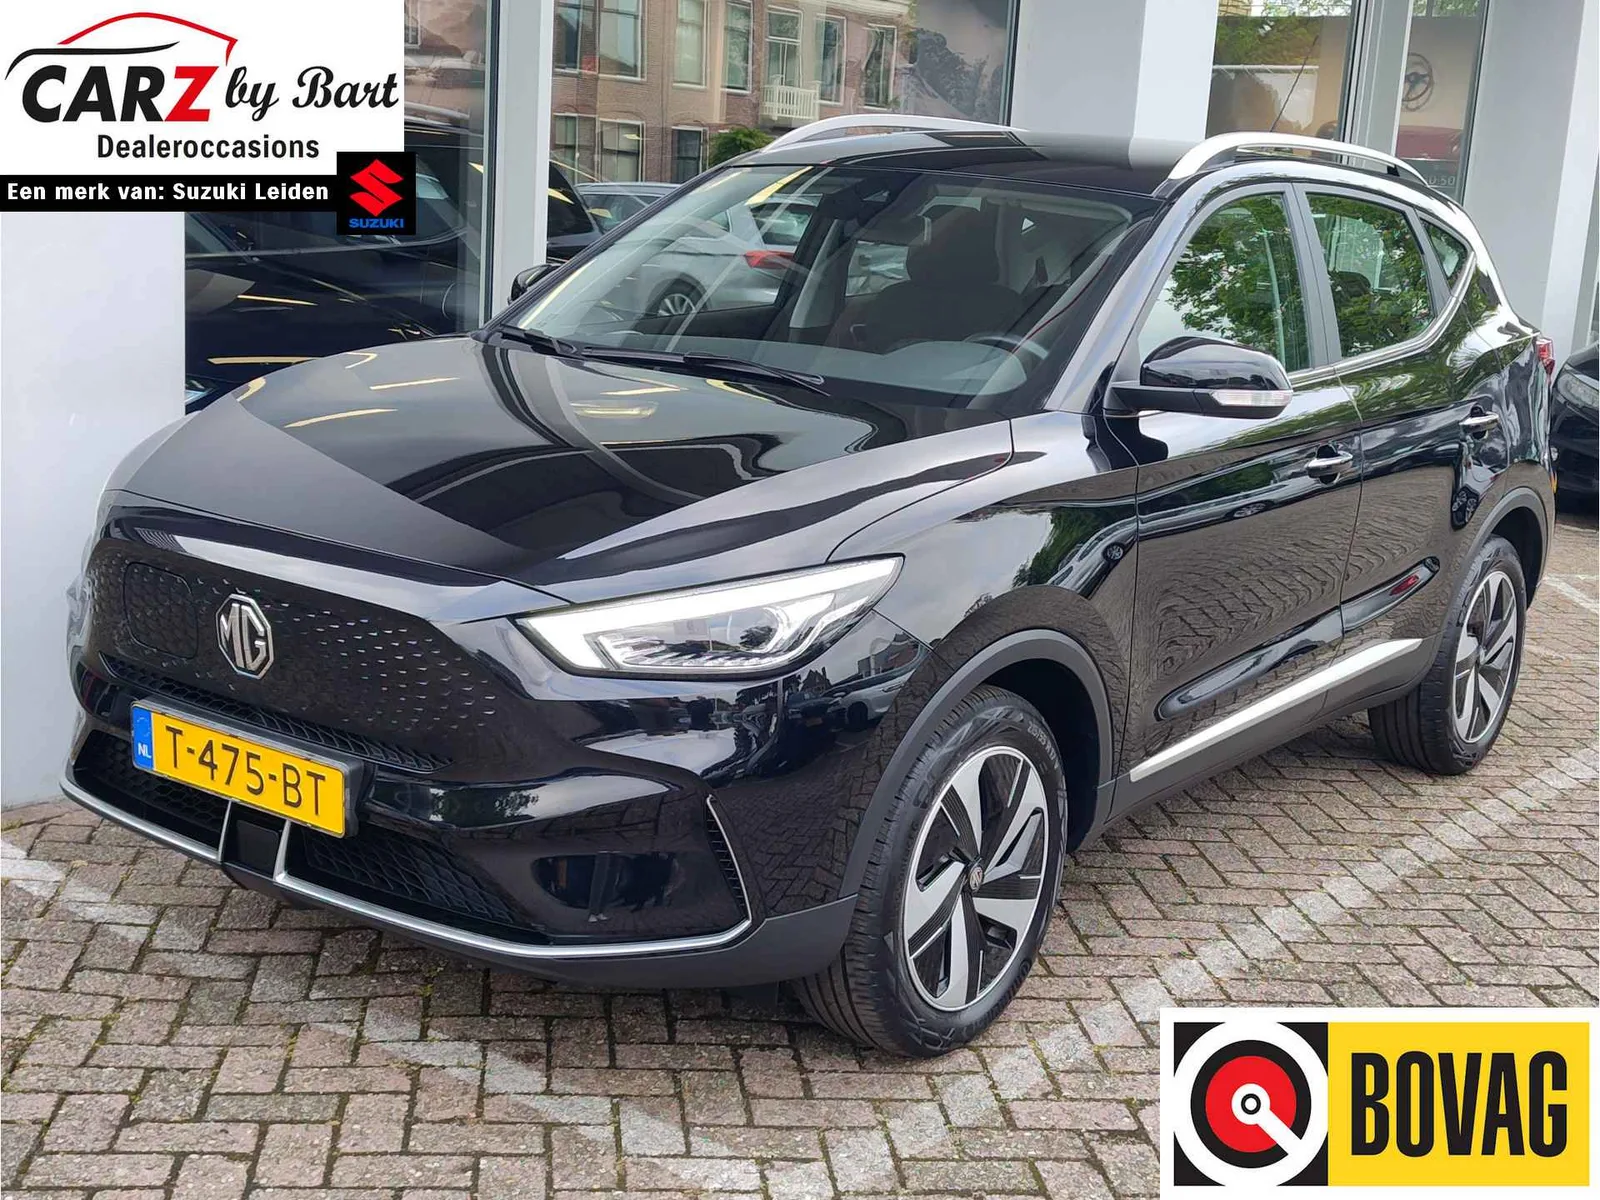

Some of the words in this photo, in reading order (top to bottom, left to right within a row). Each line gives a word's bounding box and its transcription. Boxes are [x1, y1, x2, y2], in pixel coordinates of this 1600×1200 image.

[219, 602, 267, 671] MG
[137, 742, 152, 759] NL
[165, 725, 326, 816] T-475-BT
